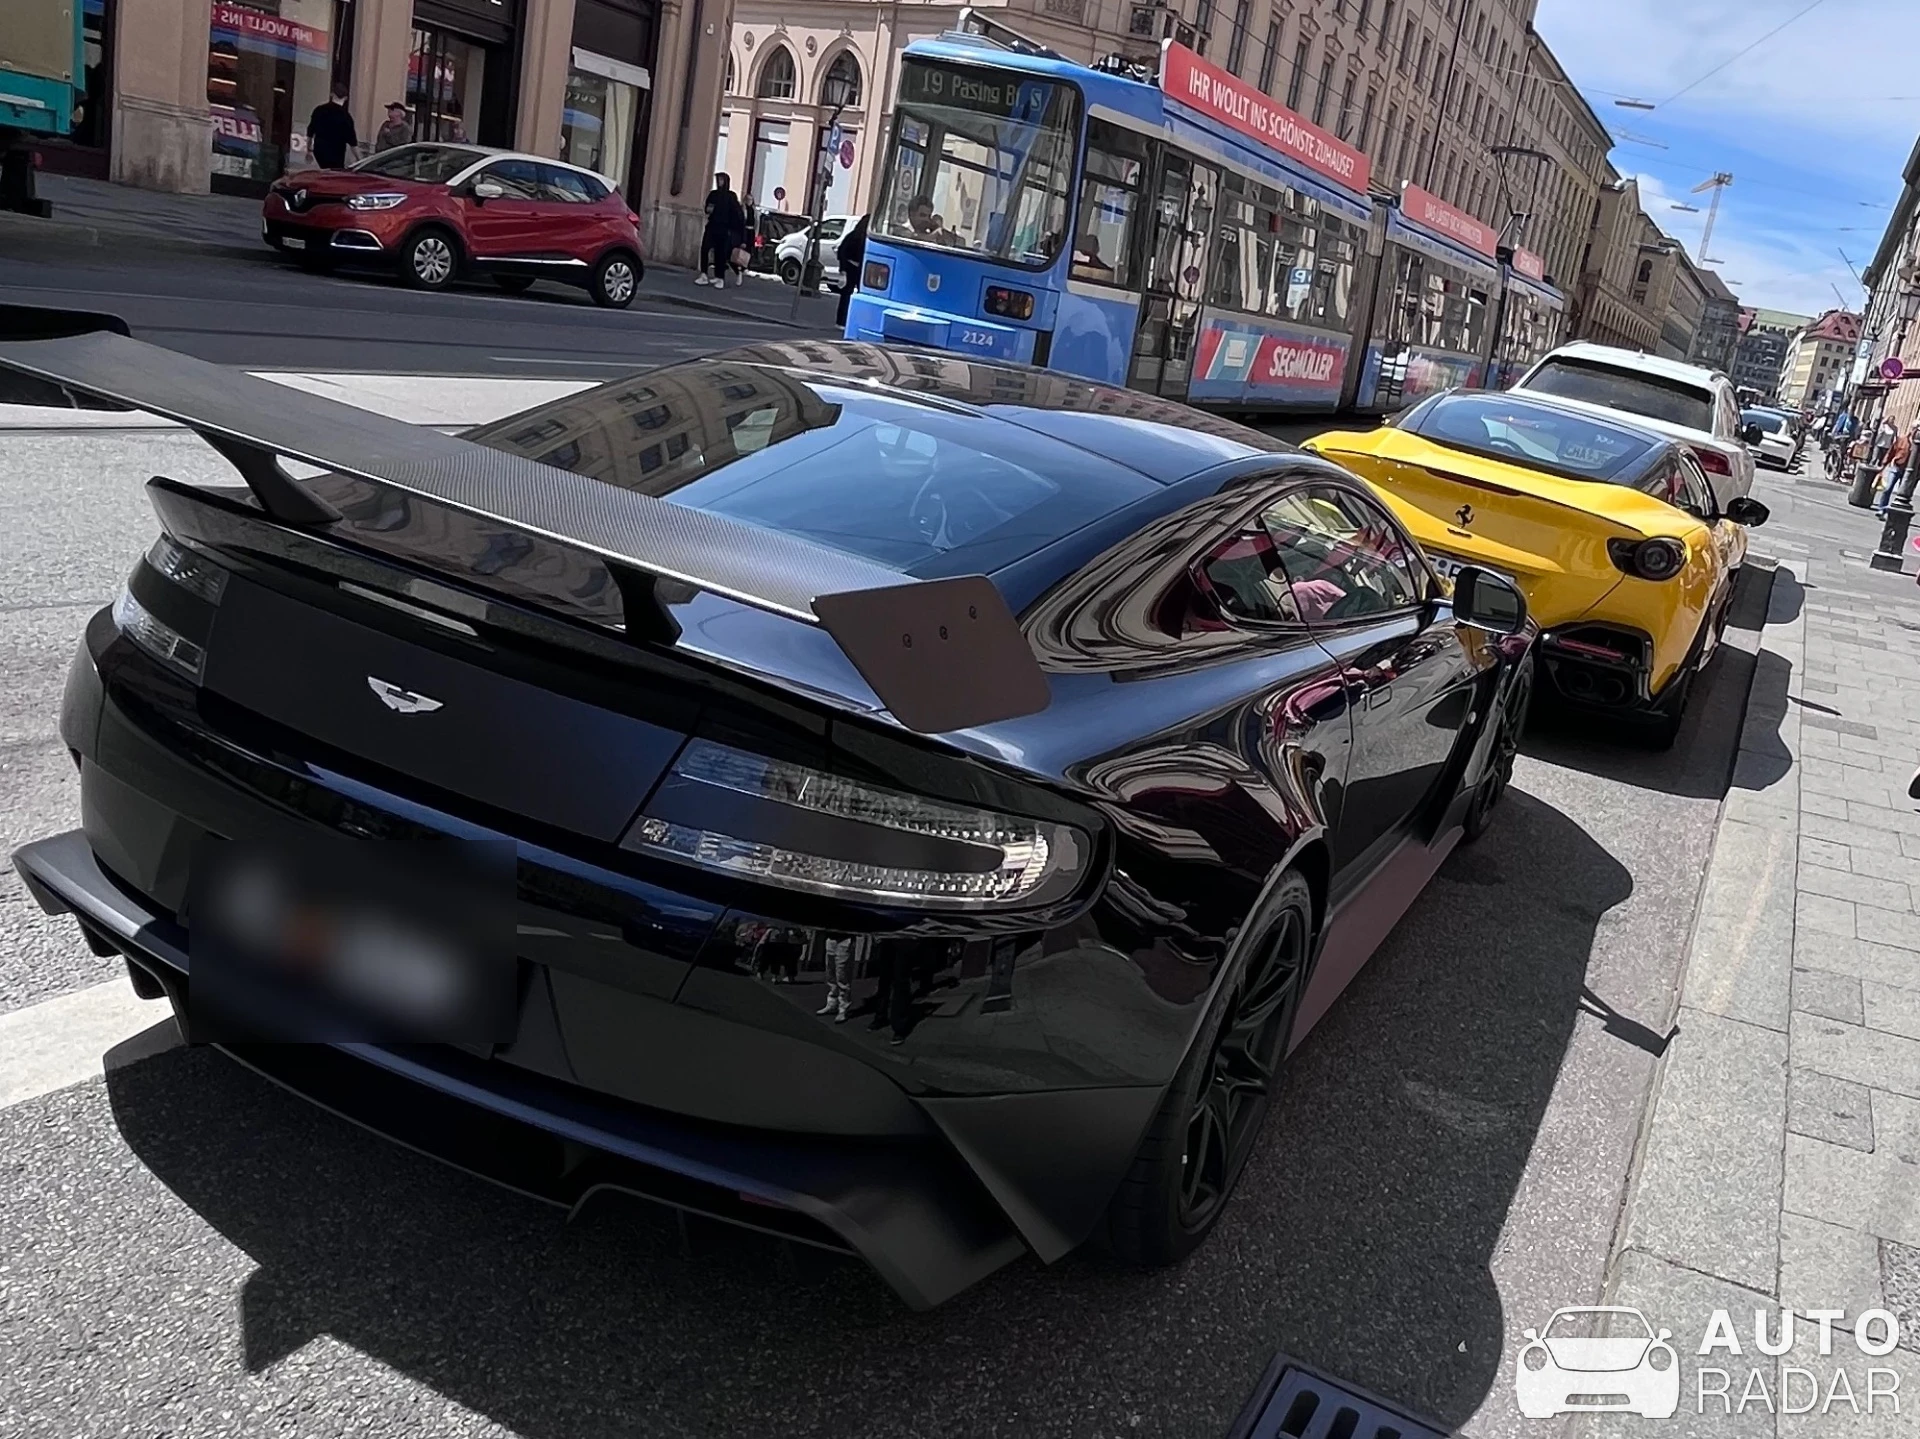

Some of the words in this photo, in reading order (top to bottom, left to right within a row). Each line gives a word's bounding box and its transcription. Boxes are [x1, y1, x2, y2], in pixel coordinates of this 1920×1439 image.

[923, 69, 943, 95] 19
[951, 75, 1000, 104] Pasing
[1188, 67, 1210, 102] IHR
[1213, 79, 1250, 122] WOLLT
[1250, 102, 1268, 132] INS
[1268, 112, 1315, 157] SCHÖNSTE
[1314, 139, 1355, 179] ZUHAUSE?
[961, 330, 993, 347] 2124
[1269, 345, 1334, 381] SEGMÜLLER
